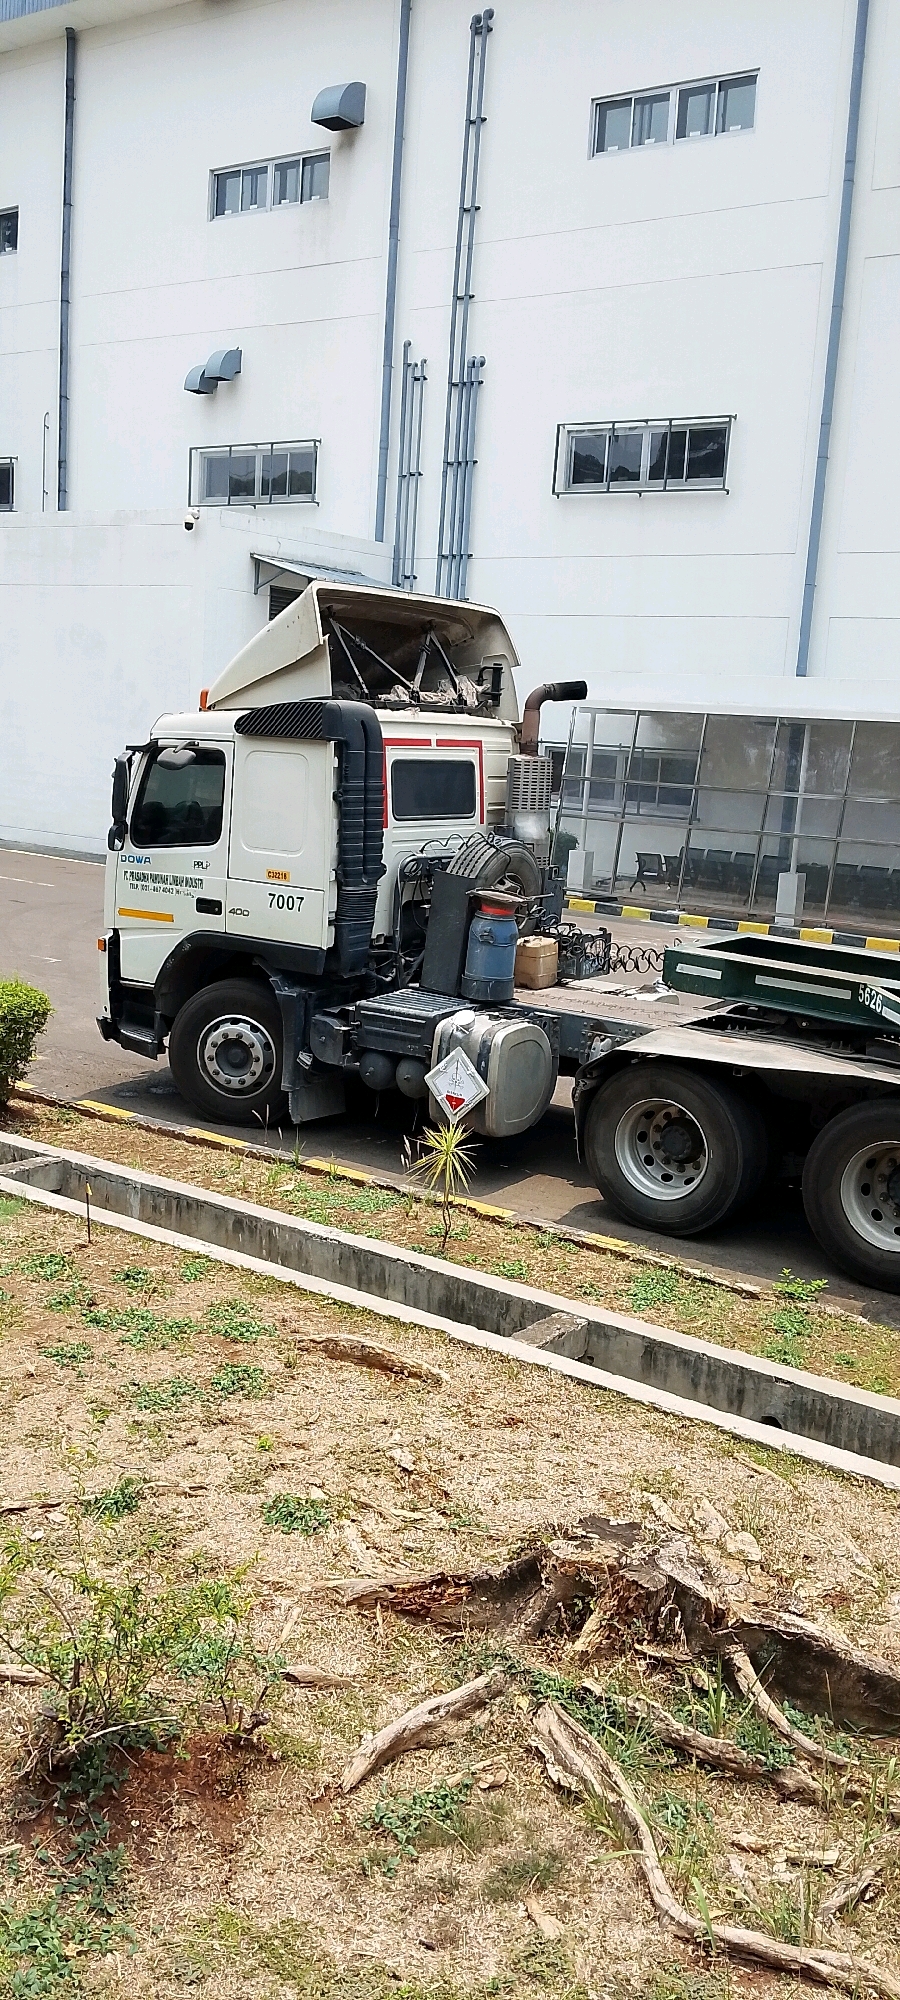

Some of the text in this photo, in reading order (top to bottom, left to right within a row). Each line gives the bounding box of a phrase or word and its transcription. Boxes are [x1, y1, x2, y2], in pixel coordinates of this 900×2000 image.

[120, 855, 151, 864] DOWA
[268, 892, 305, 912] 7007
[228, 908, 250, 917] 400
[858, 983, 883, 1013] 5626
